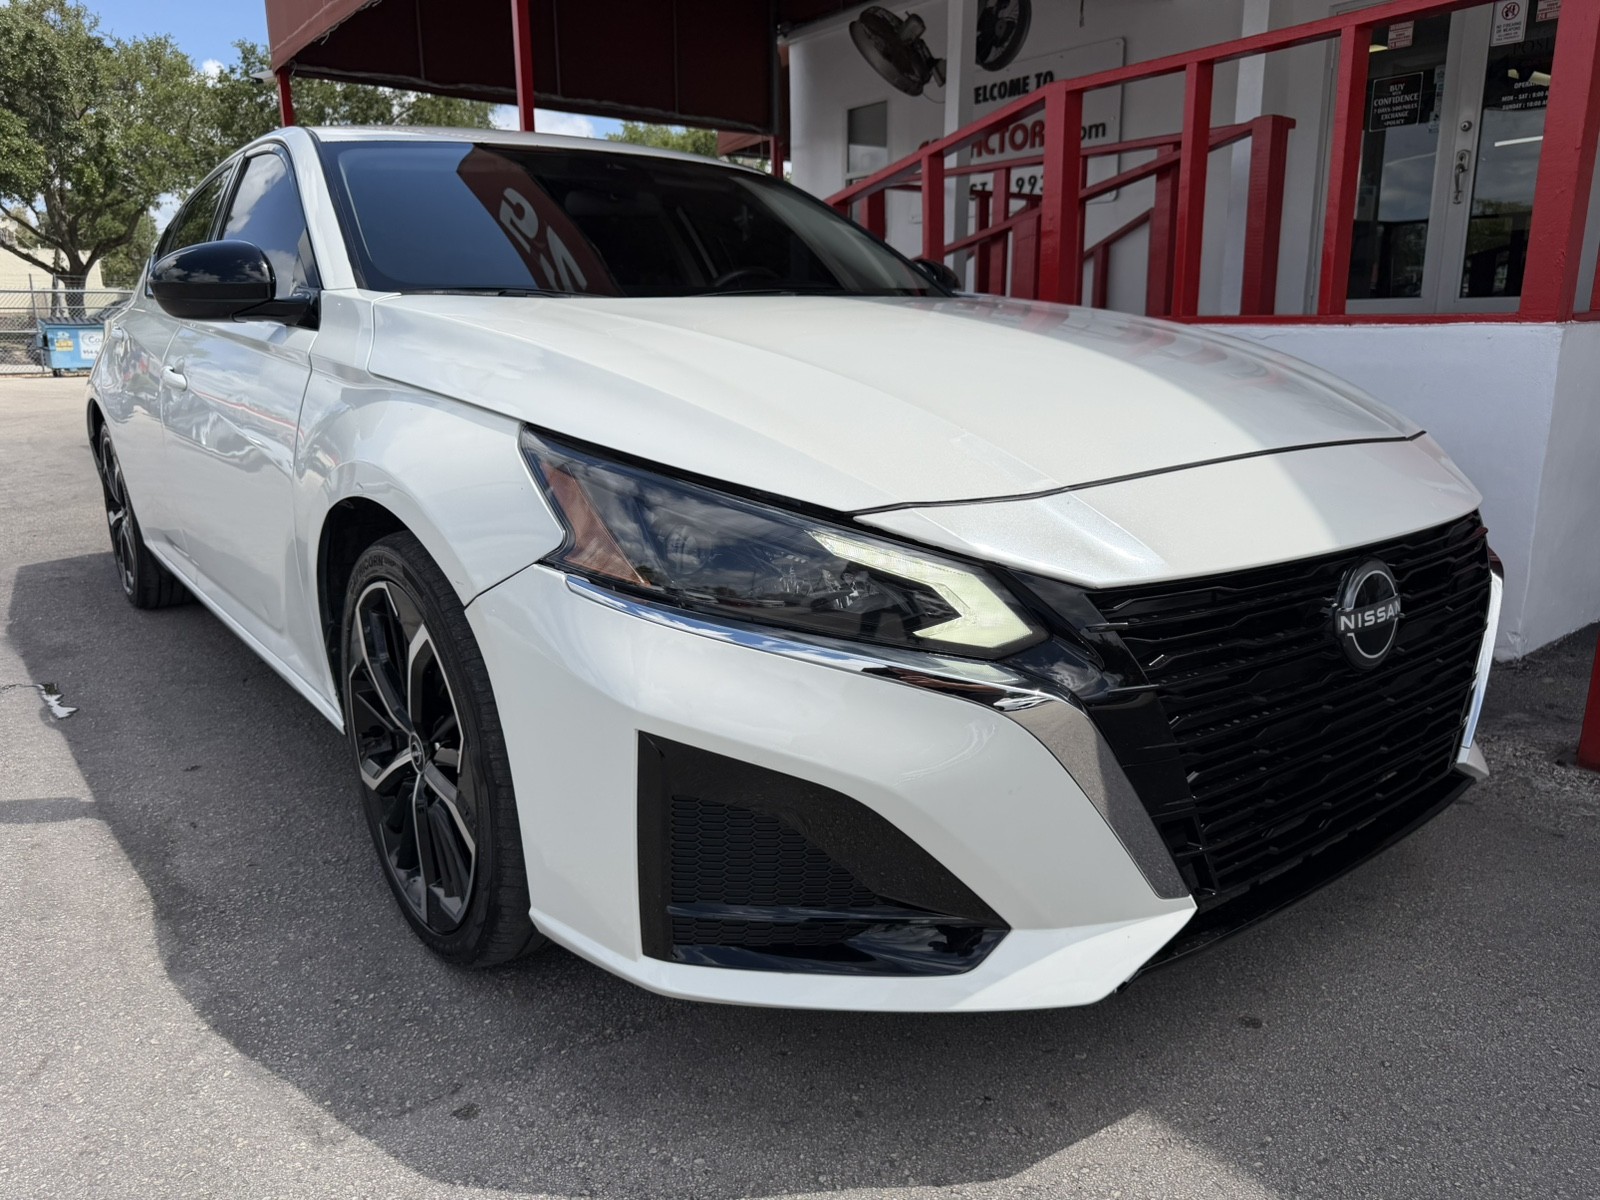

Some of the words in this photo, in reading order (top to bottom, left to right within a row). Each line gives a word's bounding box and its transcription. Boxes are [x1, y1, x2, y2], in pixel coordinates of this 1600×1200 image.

[974, 75, 1029, 105] ELCOME
[1389, 83, 1405, 92] BUY
[1374, 93, 1419, 107] CONFIDENCE
[1340, 600, 1401, 631] NISSAN
